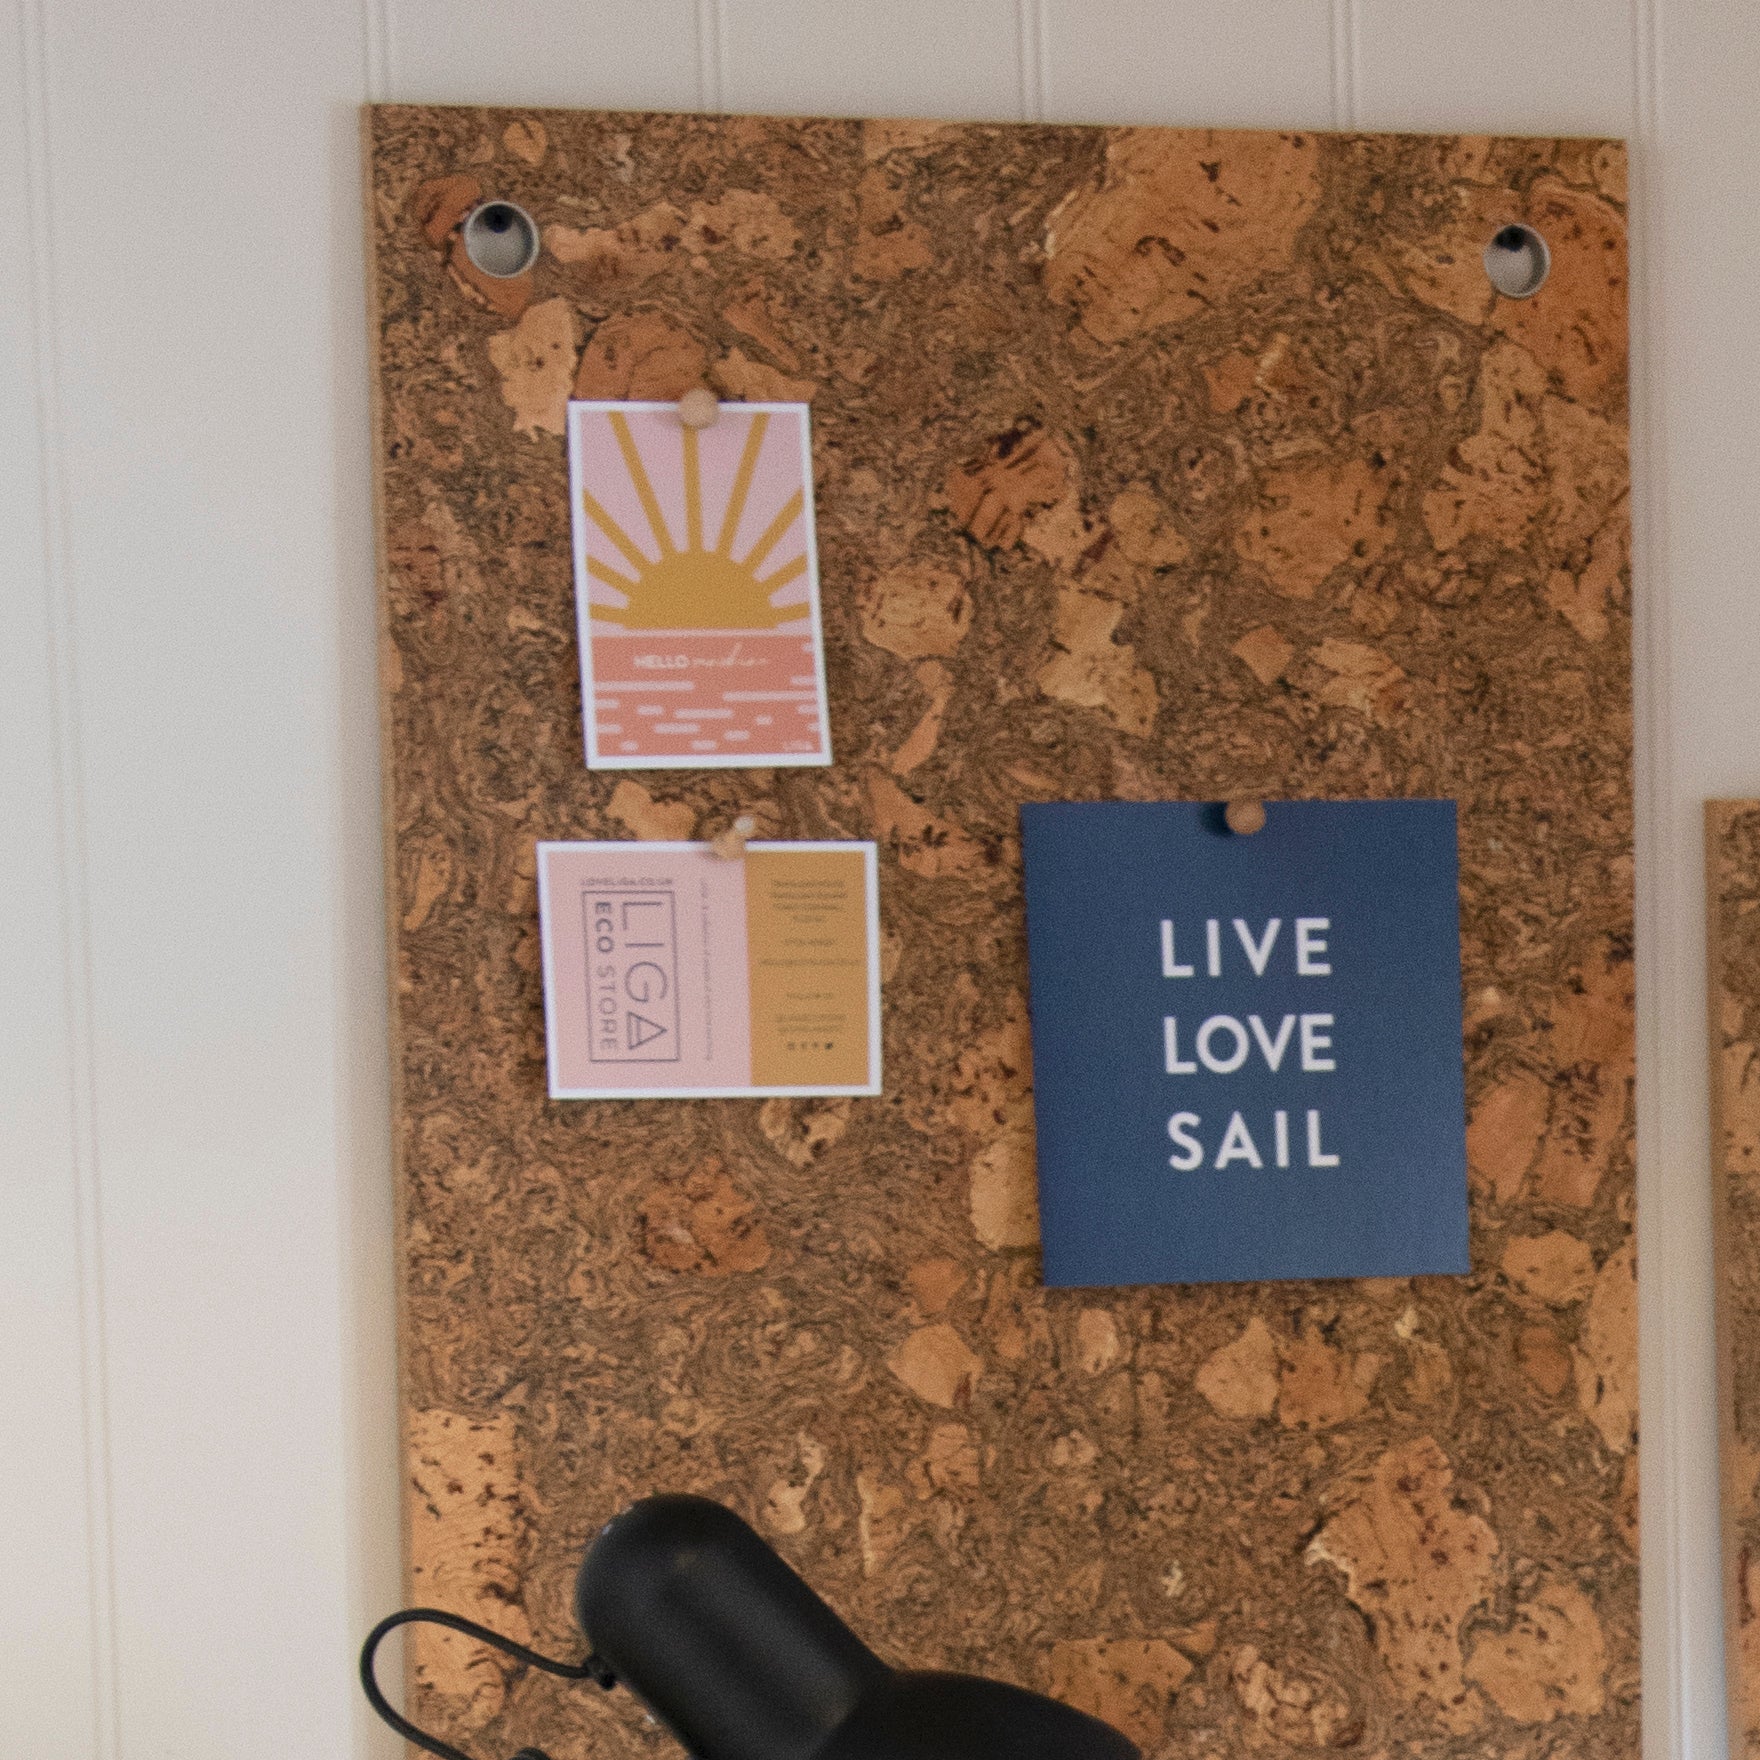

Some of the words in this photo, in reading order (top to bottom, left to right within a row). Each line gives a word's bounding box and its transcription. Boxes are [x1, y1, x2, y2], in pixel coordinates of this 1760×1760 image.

[633, 654, 690, 670] HELLO
[594, 900, 615, 955] ECO
[1160, 917, 1332, 978] LIVE
[621, 900, 669, 1051] LIGA
[597, 963, 619, 1051] STORE
[1163, 1013, 1336, 1075] LOVE
[1167, 1109, 1340, 1172] SAIL
